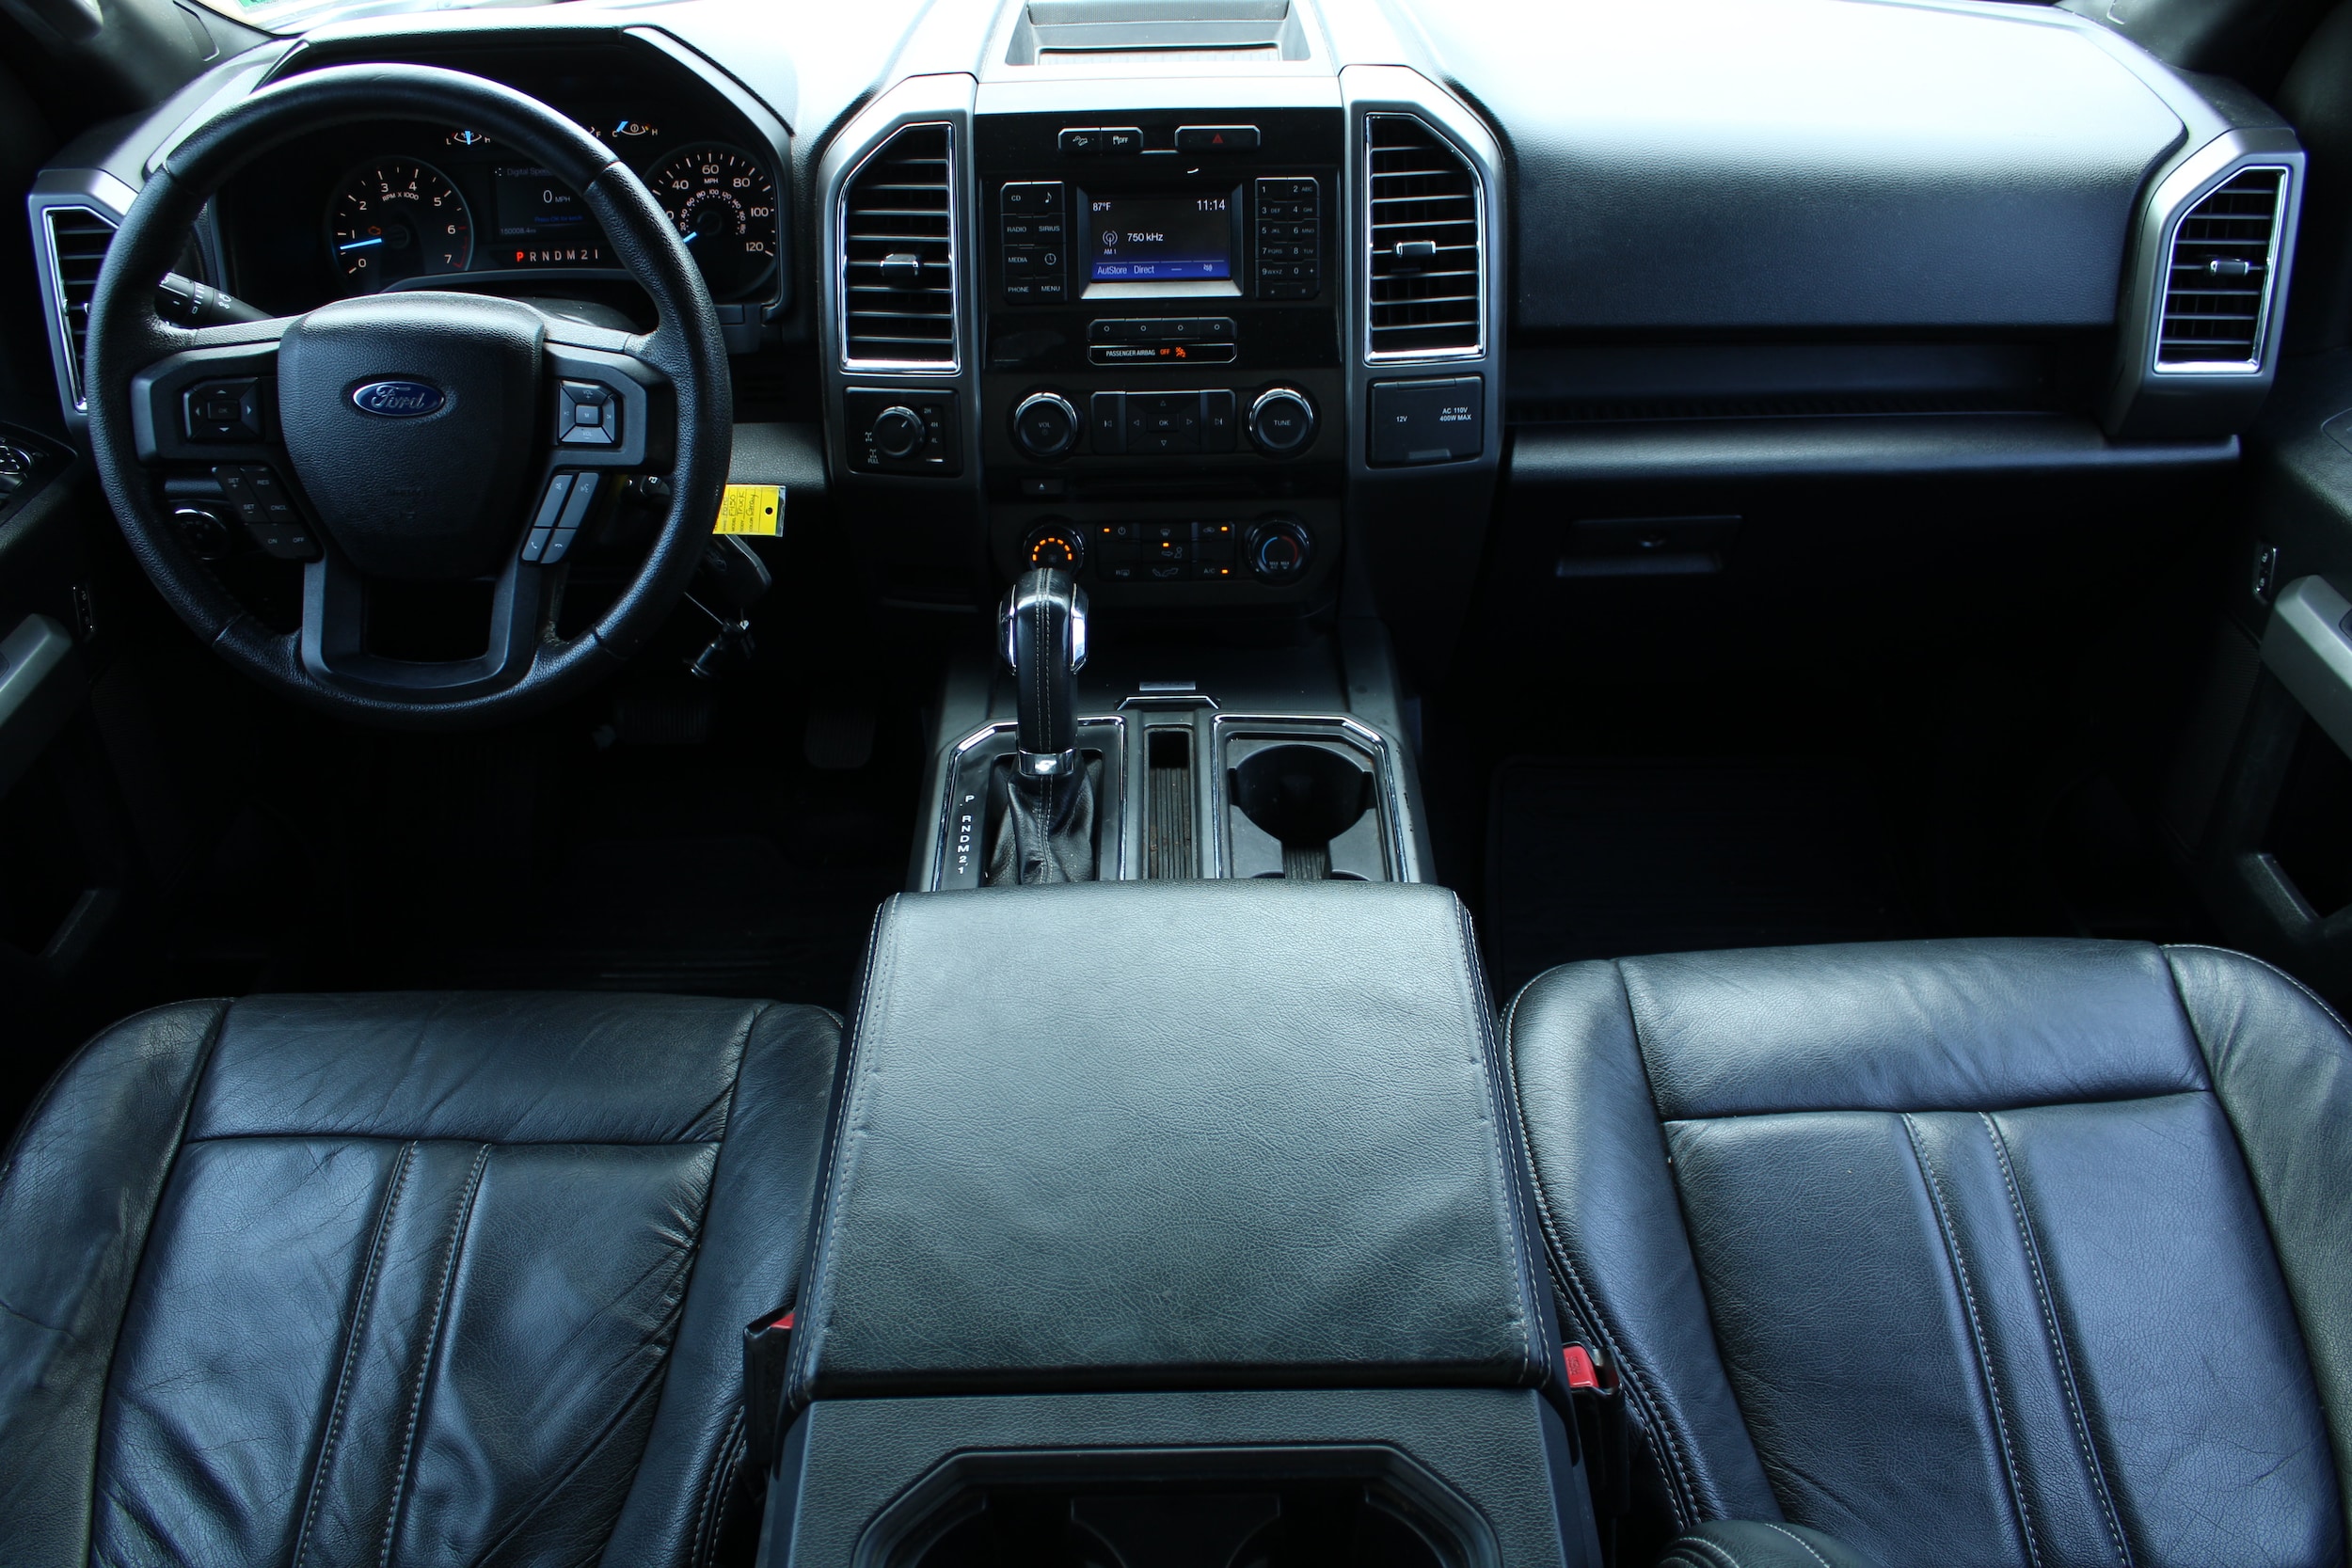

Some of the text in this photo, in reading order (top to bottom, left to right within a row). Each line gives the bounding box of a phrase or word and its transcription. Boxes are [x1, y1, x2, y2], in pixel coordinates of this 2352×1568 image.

[701, 165, 720, 175] 60
[380, 182, 389, 193] 3
[408, 181, 418, 192] 4
[672, 179, 690, 190] 40
[732, 178, 751, 188] 80
[382, 193, 396, 202] RPM
[404, 191, 420, 201] 1000
[543, 189, 553, 204] 0
[1010, 194, 1022, 202] CD
[358, 200, 368, 211] 2
[433, 197, 442, 207] 5
[1196, 198, 1226, 211] 11:14
[749, 206, 770, 217] 100
[447, 225, 456, 235] 6
[1038, 225, 1061, 233] SIRIUS
[1127, 232, 1164, 243] 750 kHz
[745, 241, 765, 252] 120
[443, 253, 453, 264] 7
[516, 249, 526, 263] P
[529, 251, 537, 262] R
[542, 250, 550, 262] N
[554, 250, 563, 261] D
[566, 249, 576, 261] M
[580, 248, 589, 261] 2
[358, 258, 368, 268] 0
[1097, 263, 1155, 275] AutStore Direct
[1008, 285, 1029, 293] PHONE
[1105, 349, 1136, 357] PASSENGER
[1158, 419, 1168, 427] OK
[1396, 415, 1408, 423] 12V
[1439, 414, 1457, 422] 400W
[964, 794, 975, 803] P
[961, 825, 971, 833] N
[960, 834, 970, 844] D
[957, 845, 970, 853] M
[959, 855, 968, 863] 2
